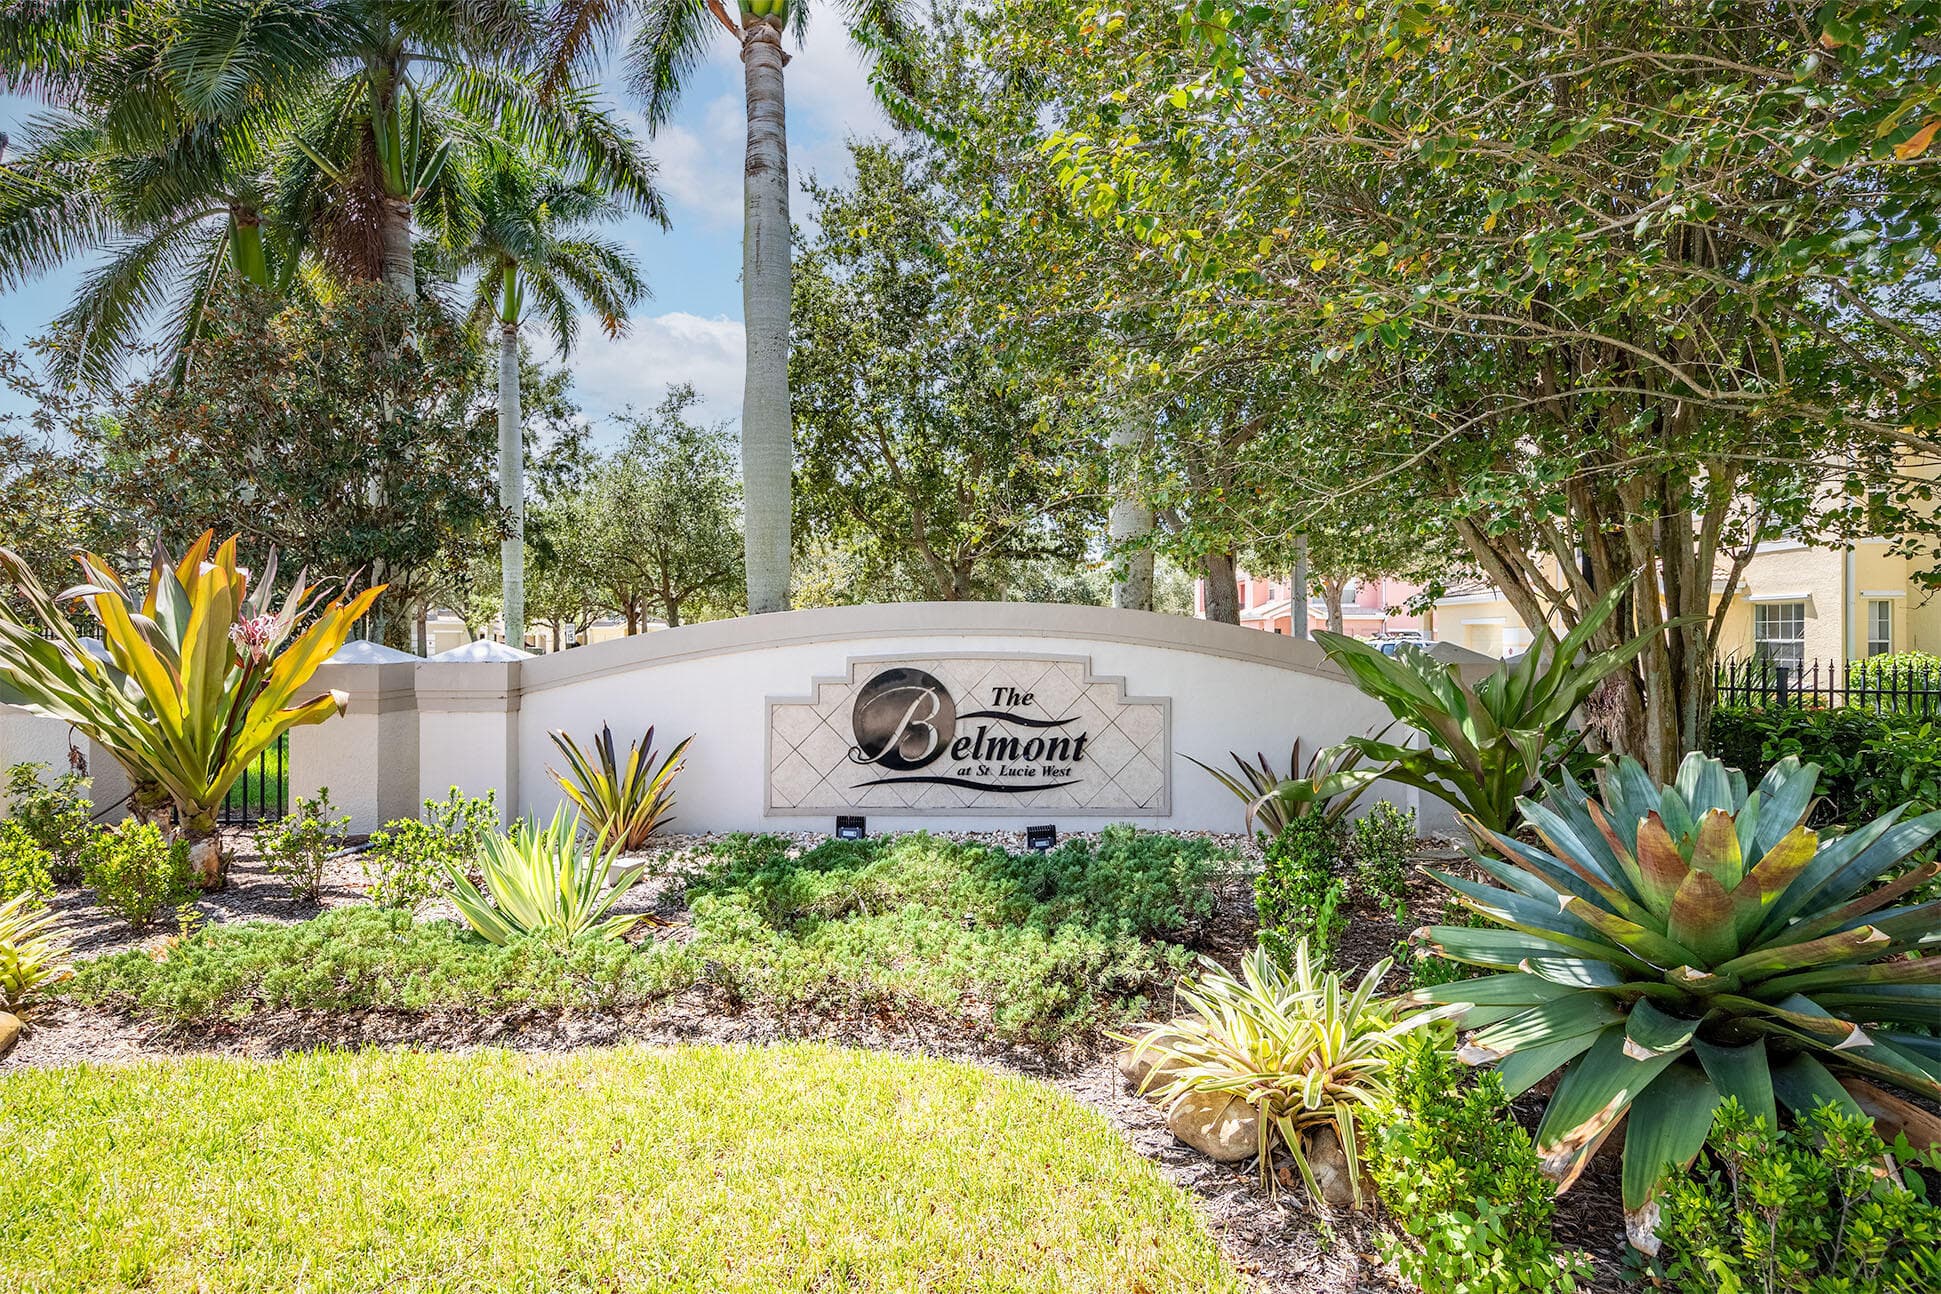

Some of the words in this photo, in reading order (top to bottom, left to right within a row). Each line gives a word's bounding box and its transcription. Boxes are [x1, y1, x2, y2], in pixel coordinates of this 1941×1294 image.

[991, 687, 1034, 706] The
[848, 686, 1087, 763] Belmont
[957, 766, 972, 776] at
[999, 765, 1036, 777] Lucie
[1042, 765, 1072, 776] West
